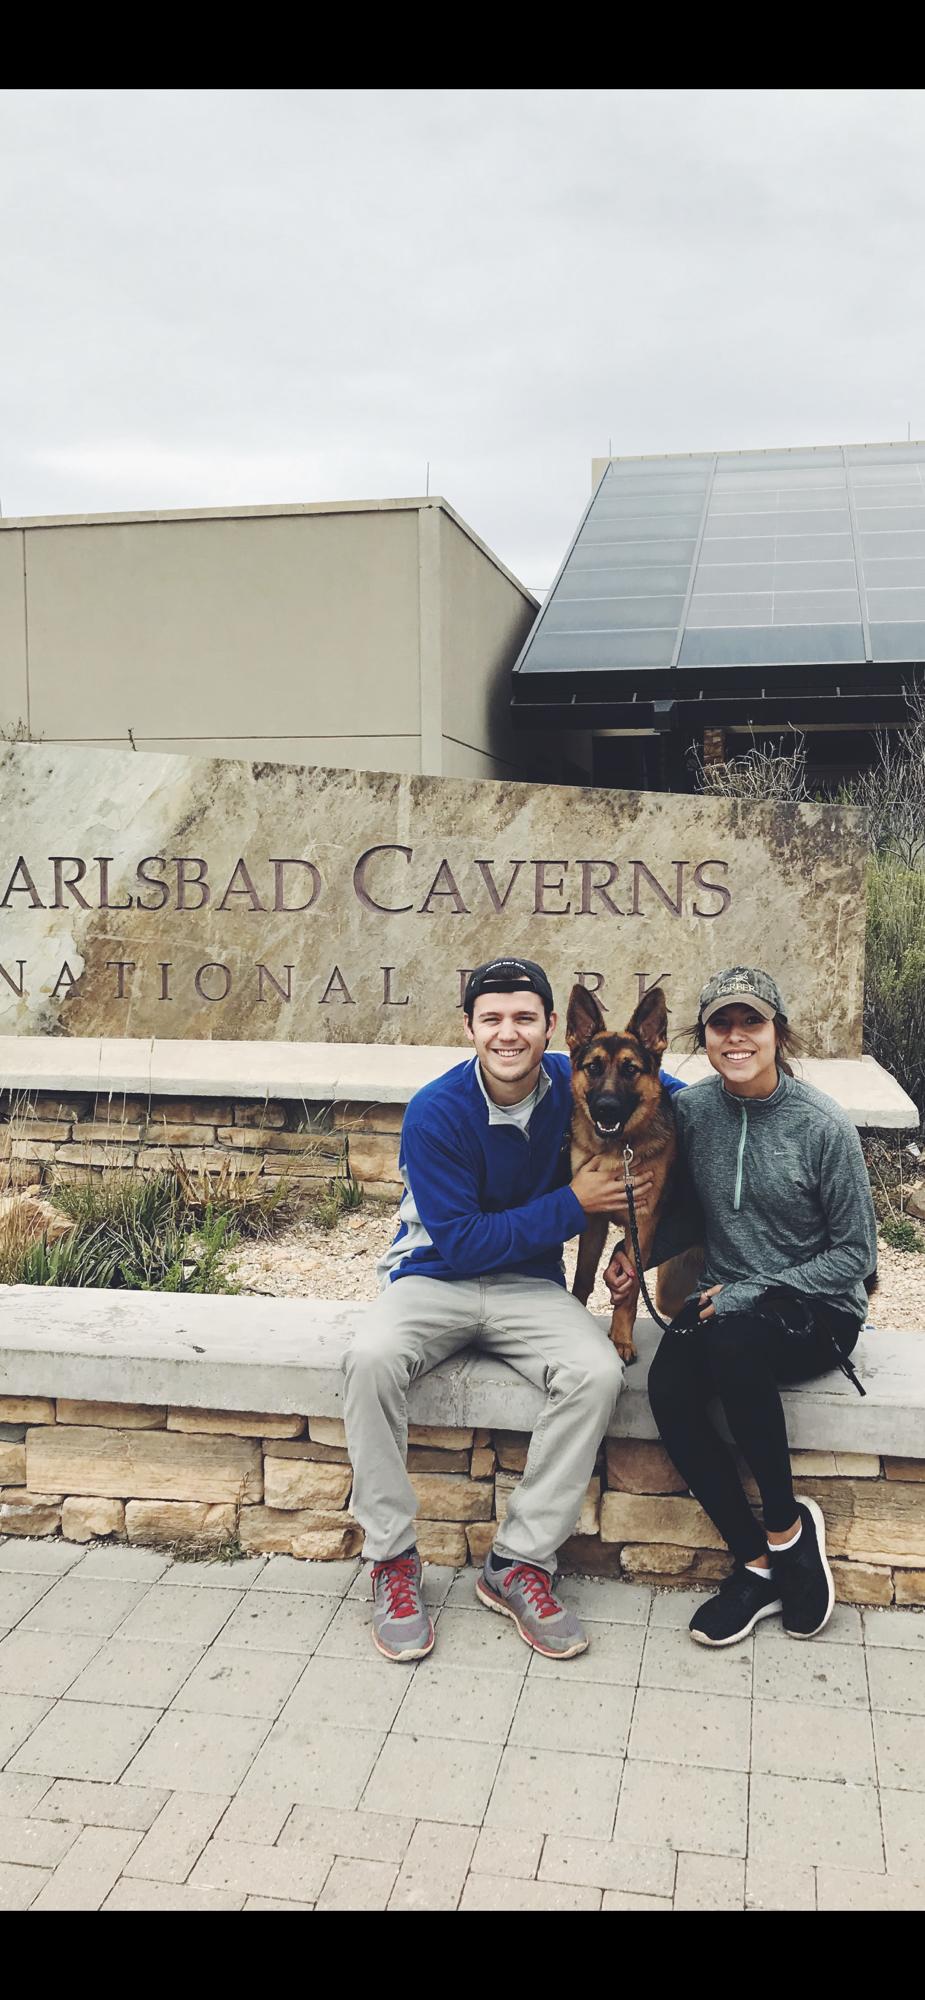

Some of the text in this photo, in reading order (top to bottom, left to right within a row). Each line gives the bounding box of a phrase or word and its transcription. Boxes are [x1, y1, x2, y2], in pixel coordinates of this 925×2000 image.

[352, 843, 733, 918] CAVERNS
[0, 959, 673, 1014] NATIONAL RK
